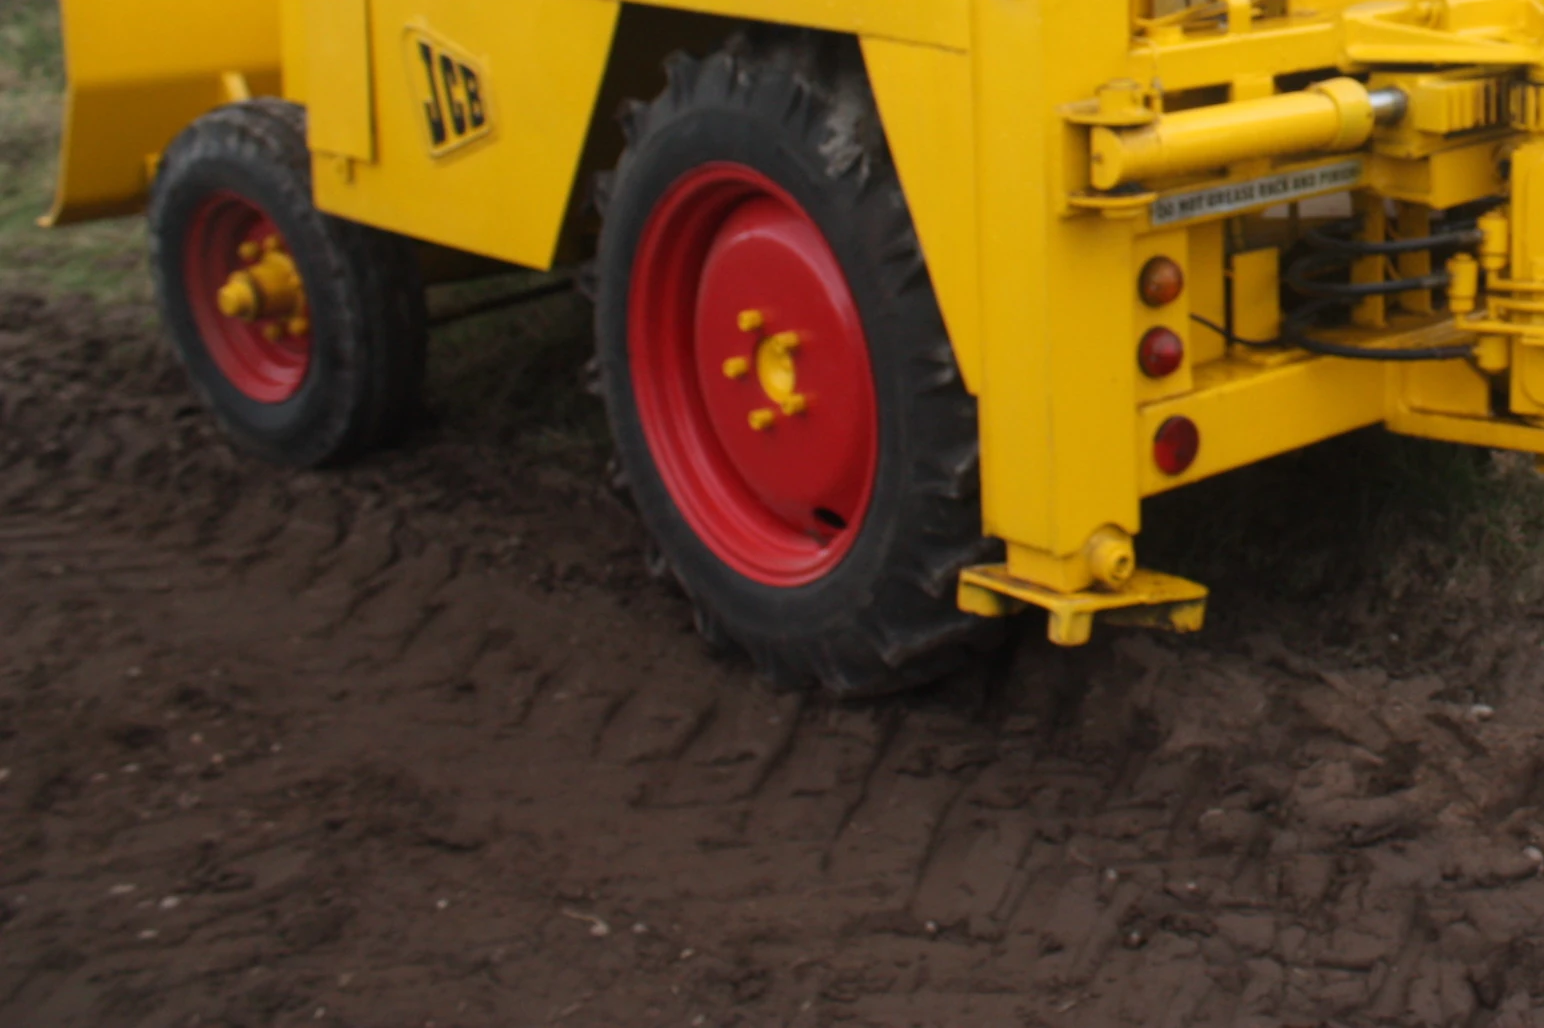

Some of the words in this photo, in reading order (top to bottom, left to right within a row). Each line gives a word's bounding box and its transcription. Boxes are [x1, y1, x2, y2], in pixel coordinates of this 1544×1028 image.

[418, 40, 485, 146] JCB
[1179, 193, 1204, 215] NOT
[1207, 183, 1255, 208] GREASE
